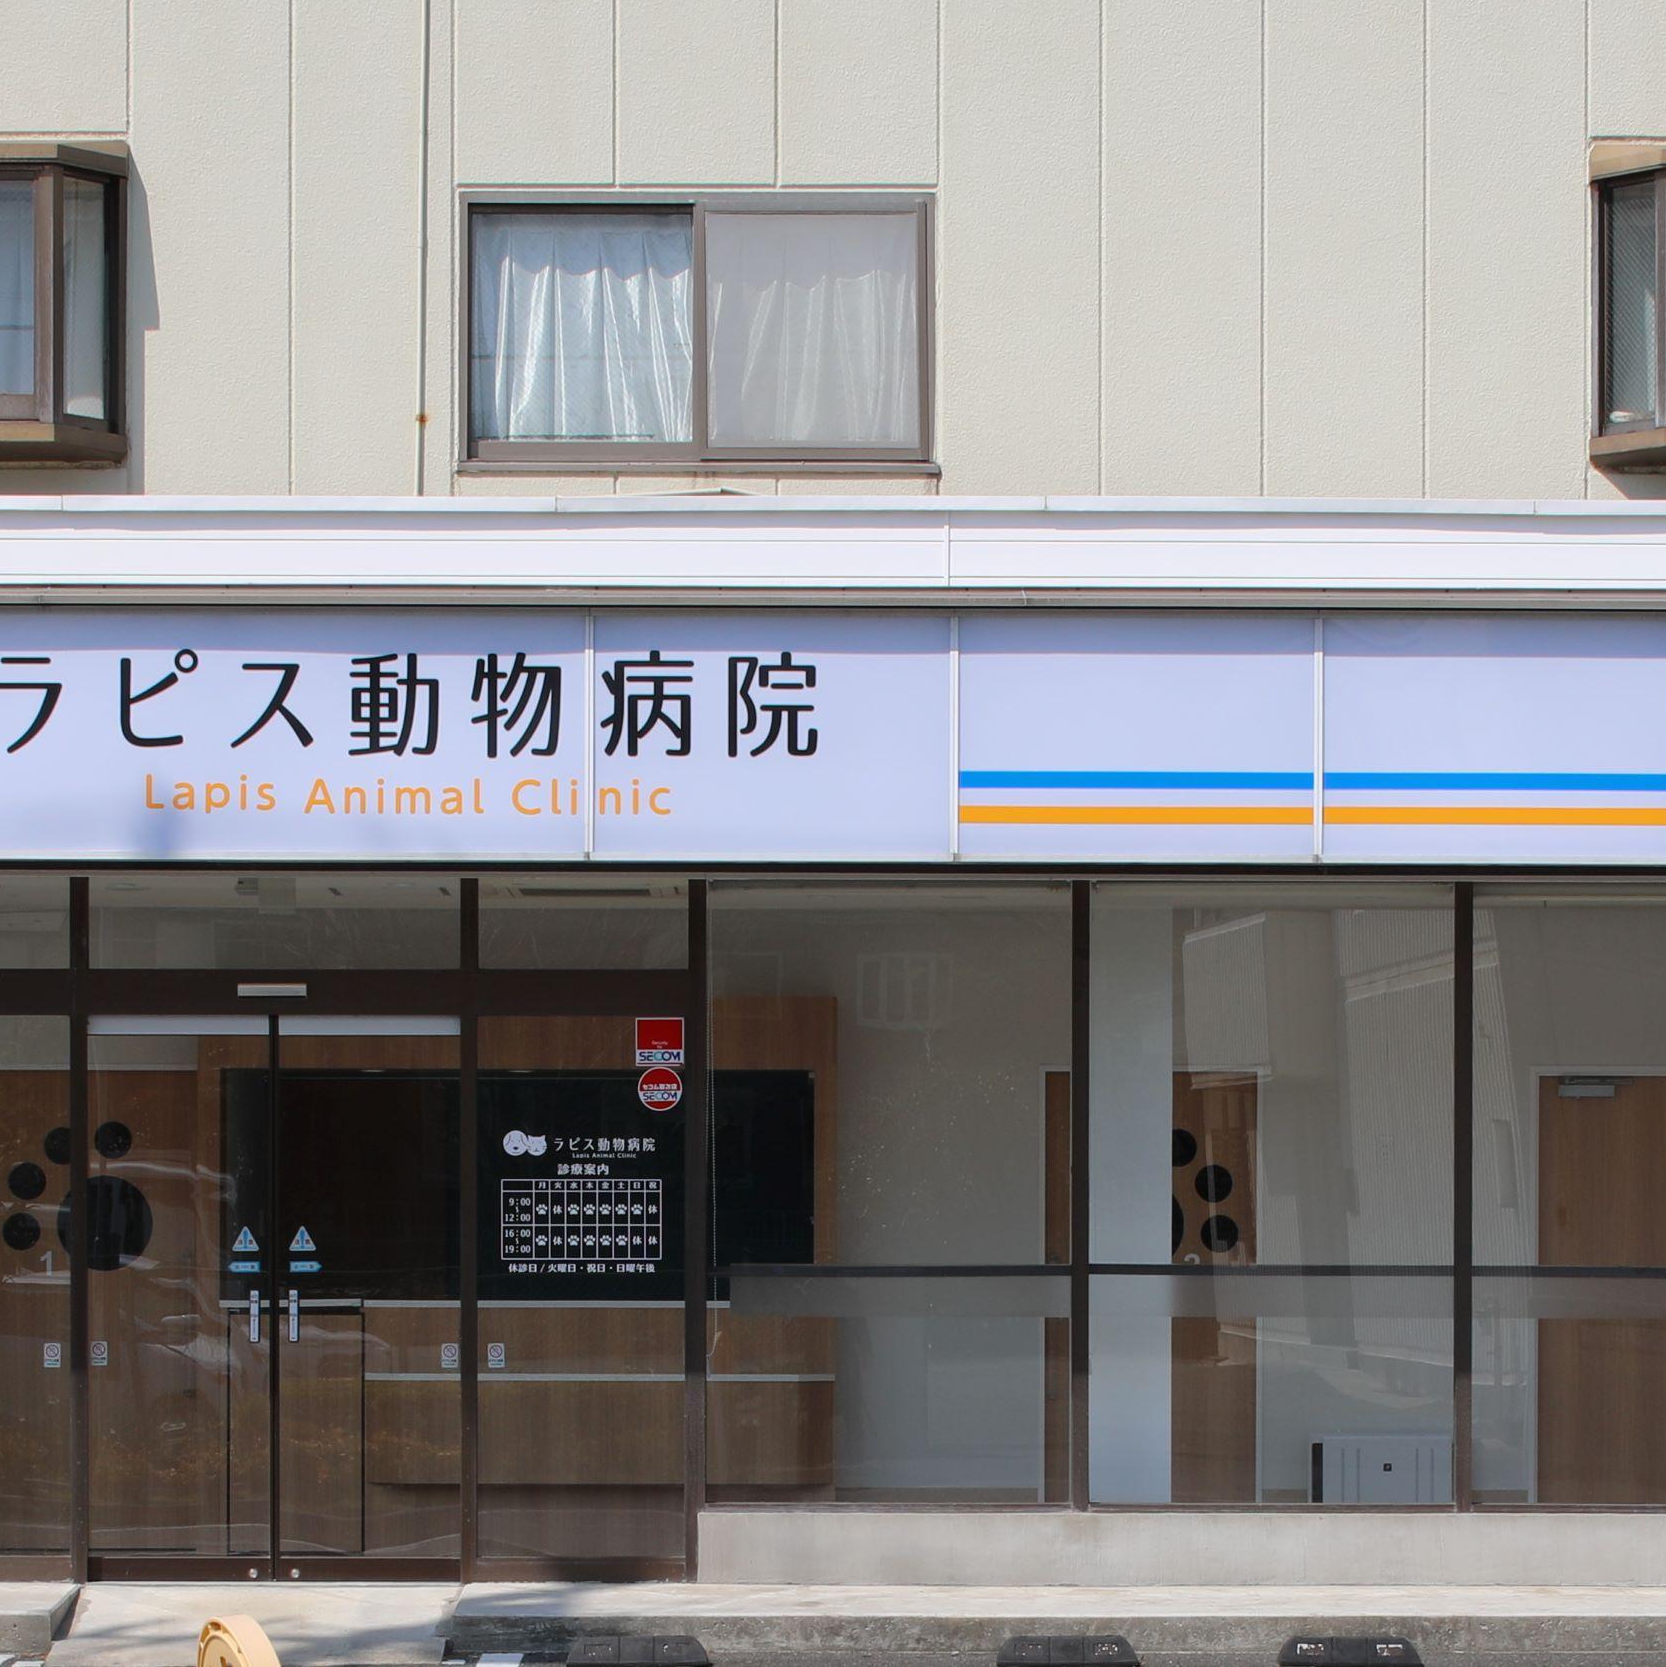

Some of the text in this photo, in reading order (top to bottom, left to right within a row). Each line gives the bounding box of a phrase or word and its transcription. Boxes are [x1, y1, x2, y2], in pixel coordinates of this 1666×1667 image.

[144, 773, 672, 816] Lapis Animal Clinic
[639, 1051, 680, 1062] SECOM
[643, 1091, 678, 1101] SECOM
[553, 1137, 656, 1152] ラピス動物病院
[557, 1163, 610, 1176] 診療案内
[538, 1182, 546, 1190] 月
[569, 1182, 578, 1190] 水
[585, 1182, 594, 1190] 木
[601, 1182, 610, 1190] 金
[617, 1182, 625, 1190] 土
[633, 1182, 641, 1190] 日
[508, 1197, 531, 1206] 9:00
[552, 1205, 658, 1215] 休 休
[504, 1213, 531, 1223] 12:00
[504, 1229, 531, 1238] 16:00
[552, 1236, 658, 1246] 休 休 休
[504, 1245, 531, 1254] 19:00
